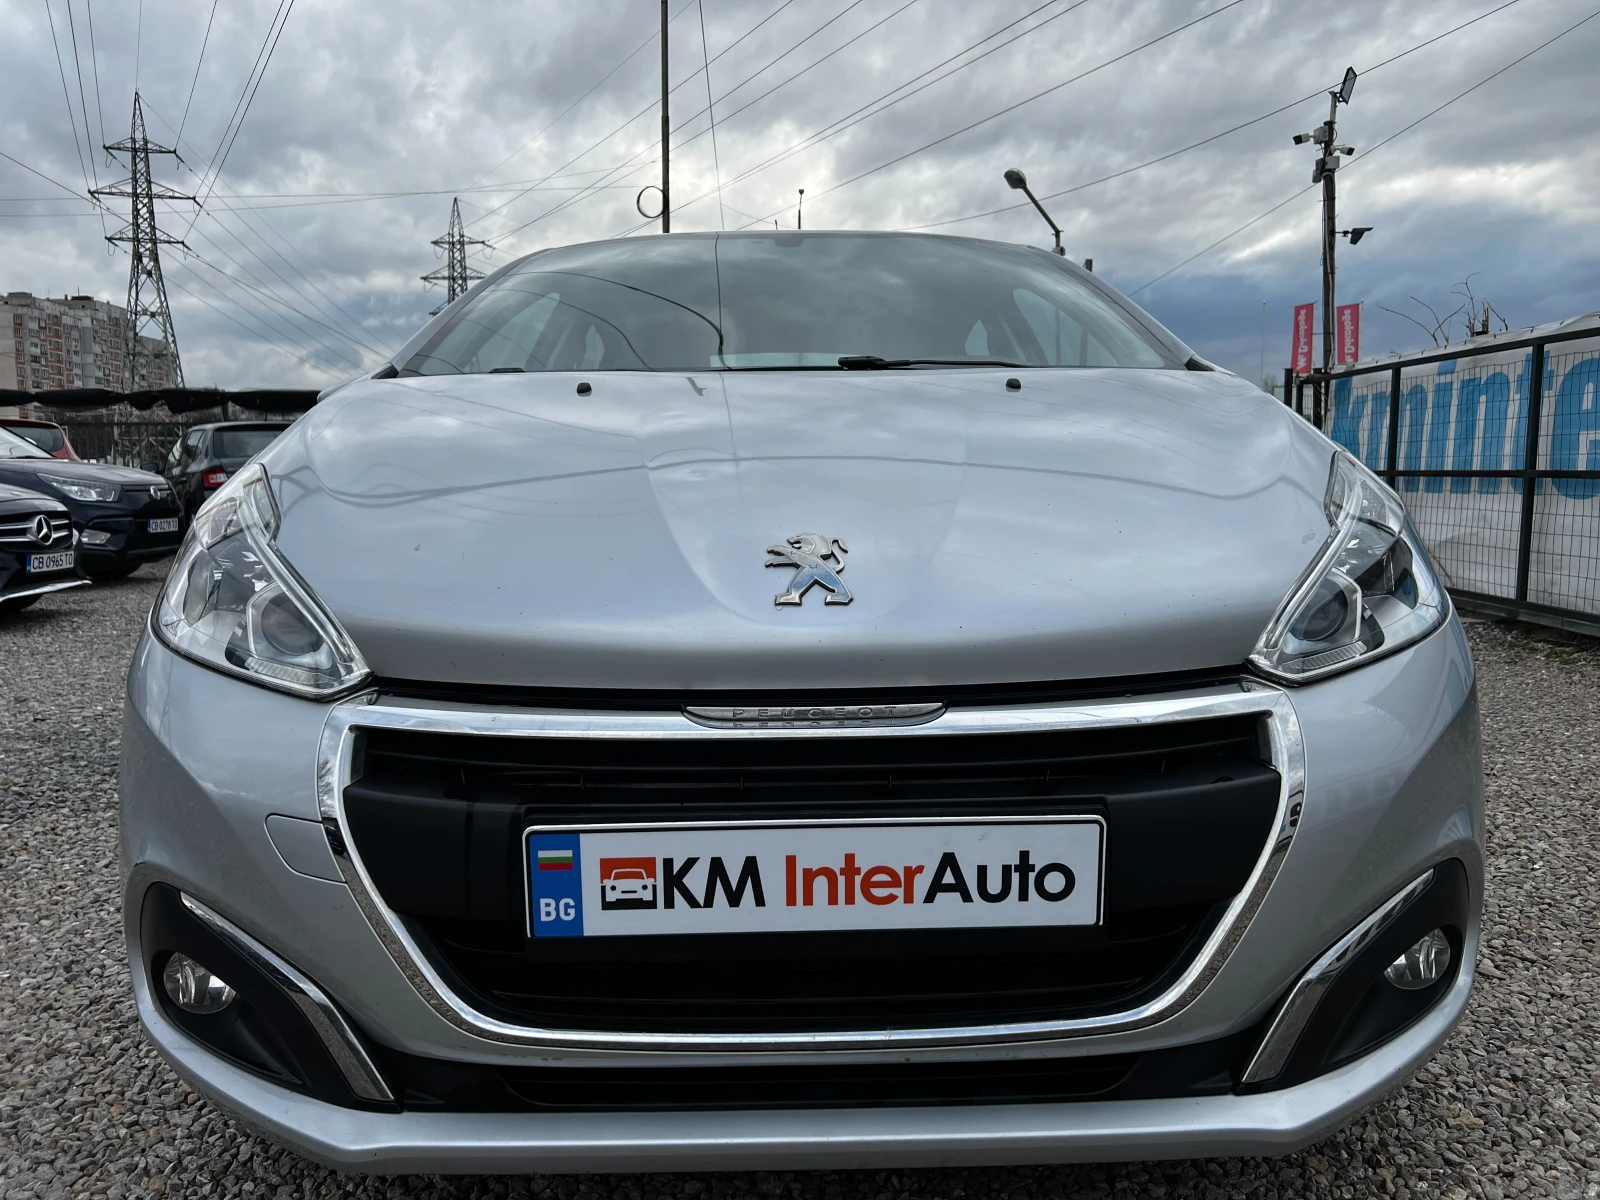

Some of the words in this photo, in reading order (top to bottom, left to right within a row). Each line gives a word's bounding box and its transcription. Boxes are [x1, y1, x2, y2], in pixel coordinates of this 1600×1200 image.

[151, 520, 159, 531] CB
[32, 556, 44, 570] CB
[46, 554, 64, 569] 0965
[732, 706, 897, 718] PEUGEOT
[662, 855, 767, 909] KM
[786, 850, 1076, 907] InterAuto
[539, 898, 576, 922] BG
